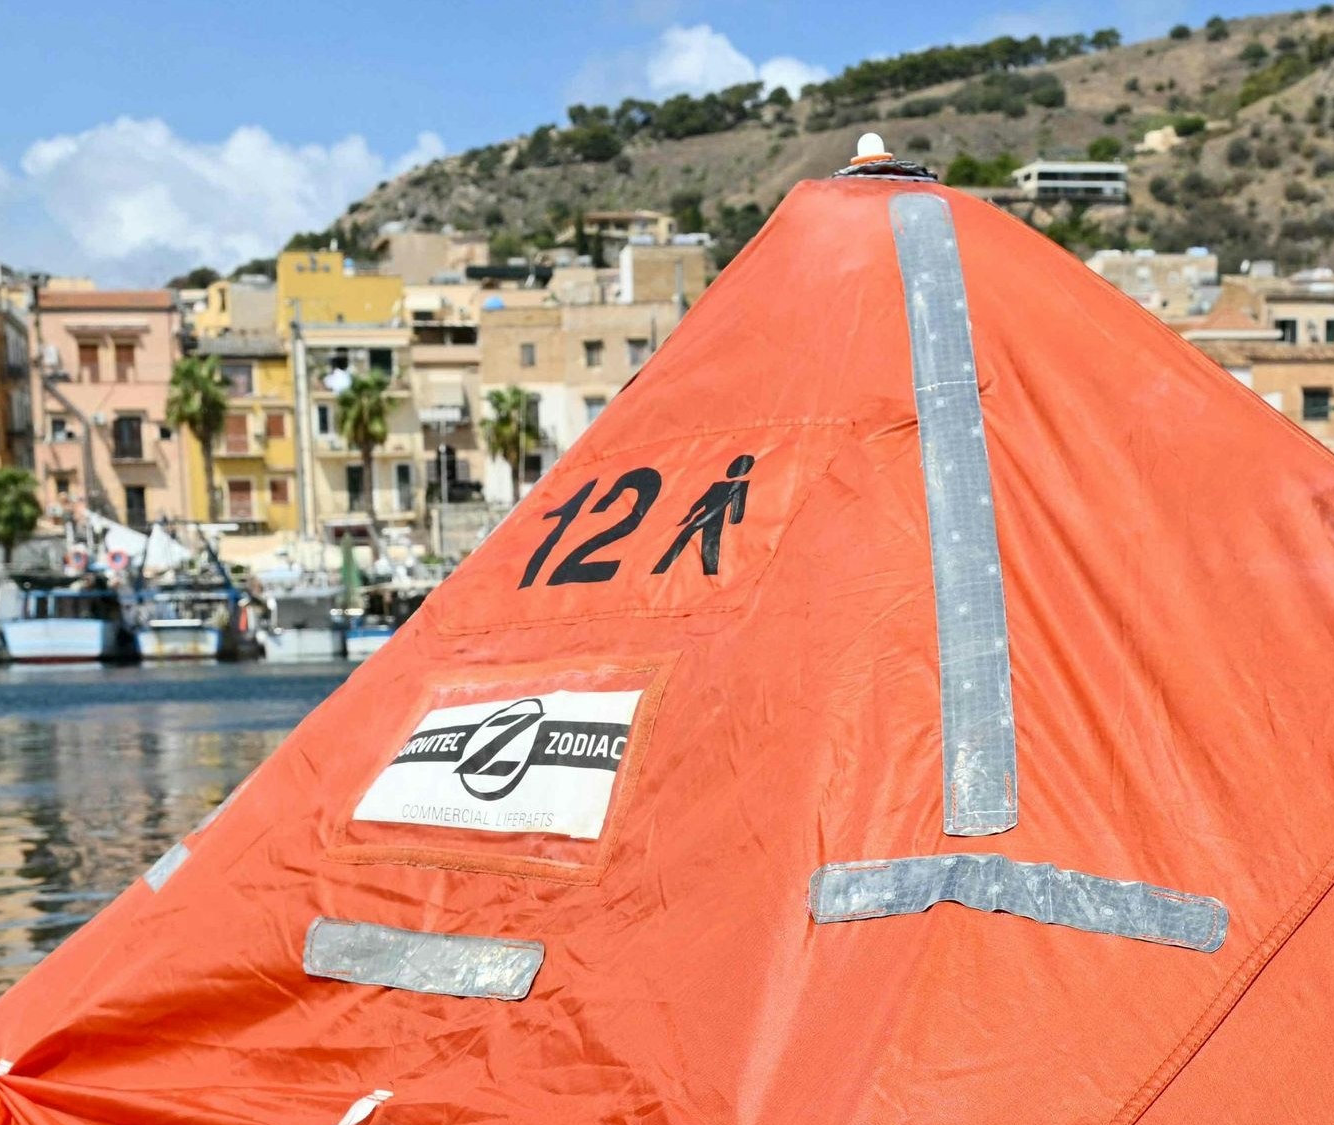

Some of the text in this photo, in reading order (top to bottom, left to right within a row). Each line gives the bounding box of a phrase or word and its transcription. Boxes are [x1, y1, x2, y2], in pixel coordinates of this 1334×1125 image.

[517, 467, 662, 590] 12
[544, 731, 628, 761] ZODIAC
[401, 803, 555, 828] COMMERCIAL LIFERAFTS
